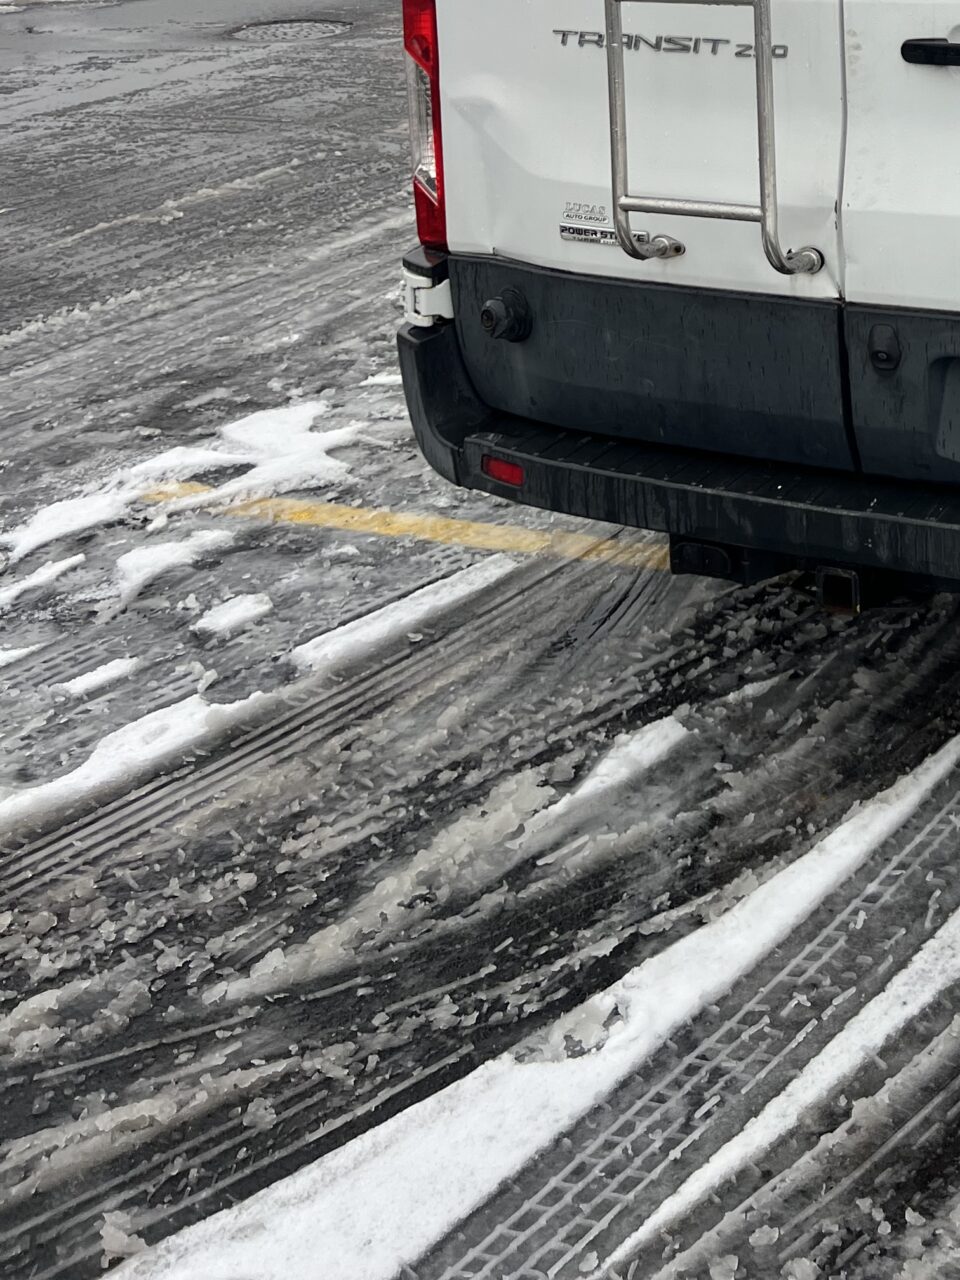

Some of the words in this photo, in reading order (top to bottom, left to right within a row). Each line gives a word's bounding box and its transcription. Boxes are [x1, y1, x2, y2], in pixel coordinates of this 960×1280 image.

[734, 43, 789, 59] 20
[564, 201, 606, 215] LUCAS
[583, 215, 607, 223] GROUP
[561, 226, 598, 238] POWER
[600, 230, 646, 243] STE
